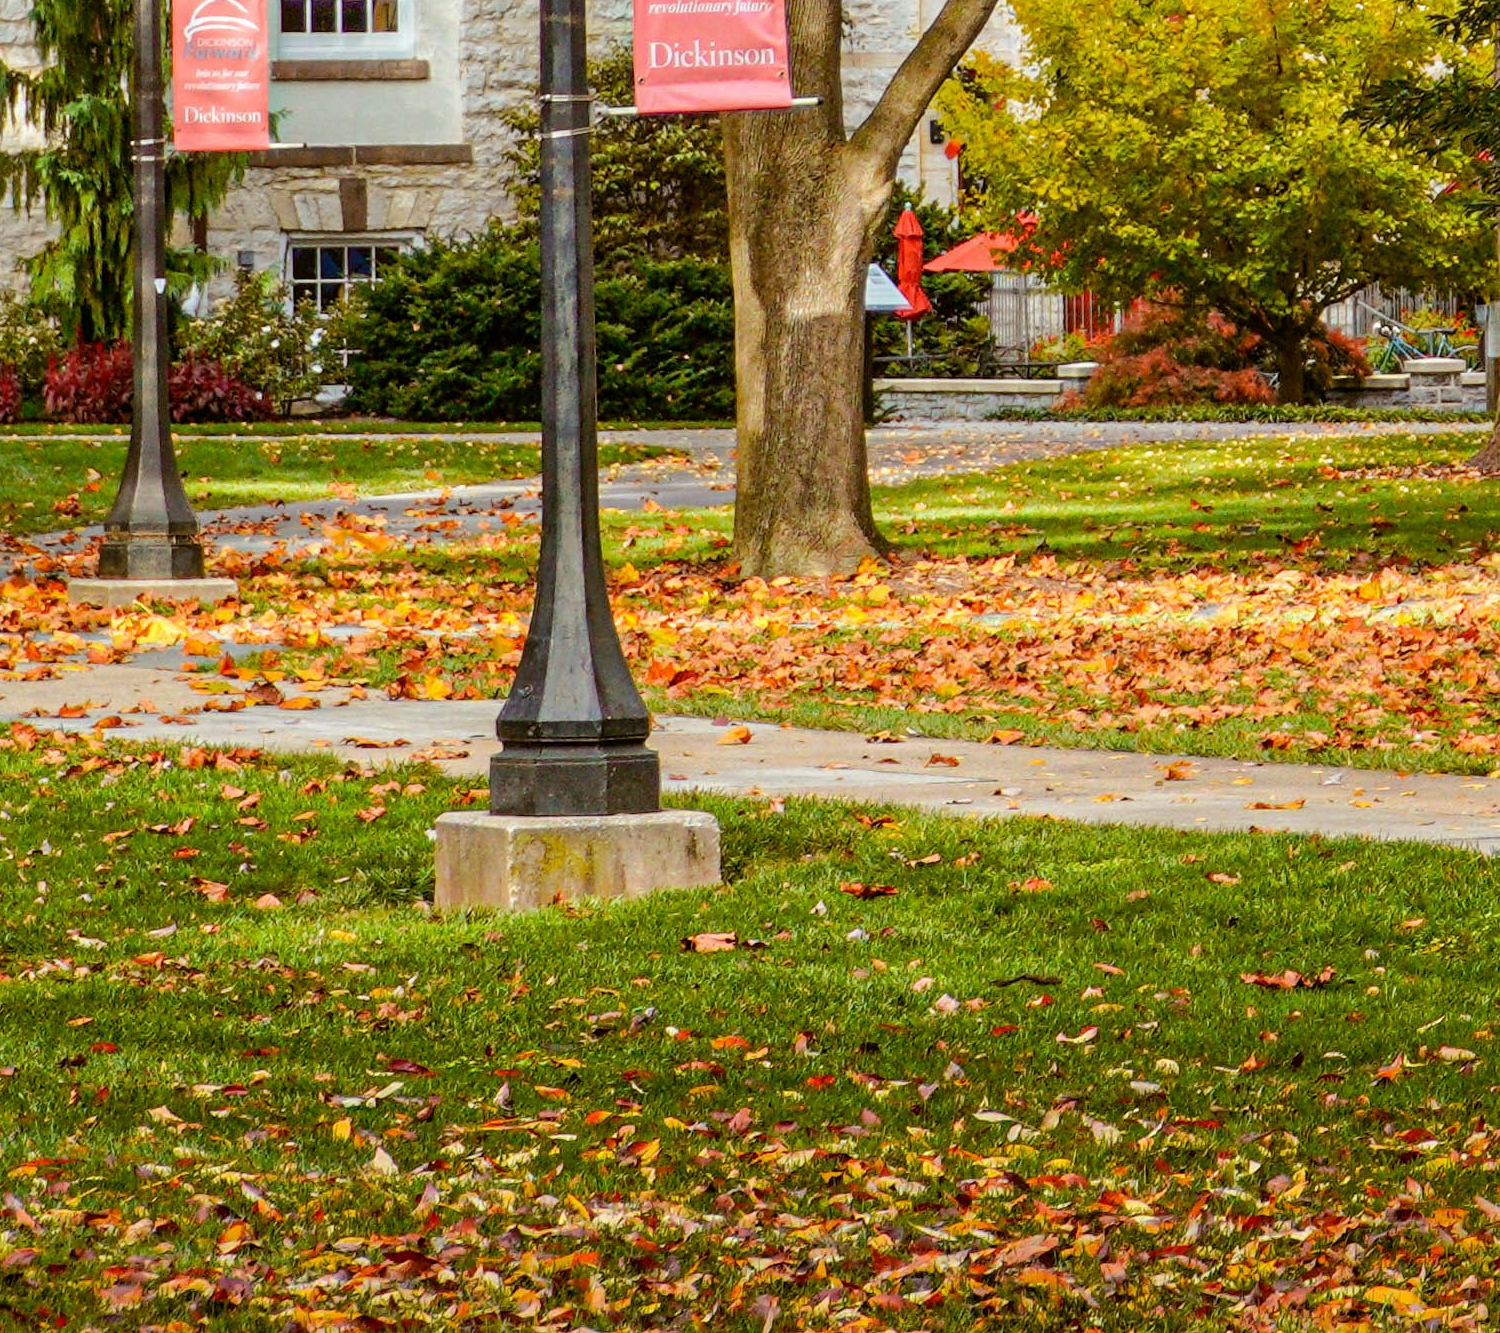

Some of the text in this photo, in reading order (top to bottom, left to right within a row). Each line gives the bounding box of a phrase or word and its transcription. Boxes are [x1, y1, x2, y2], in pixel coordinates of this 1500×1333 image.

[648, 0, 734, 16] revolutionary
[197, 37, 254, 47] DICKINSON
[649, 39, 775, 69] Dickinson
[184, 105, 261, 123] Dickinson
